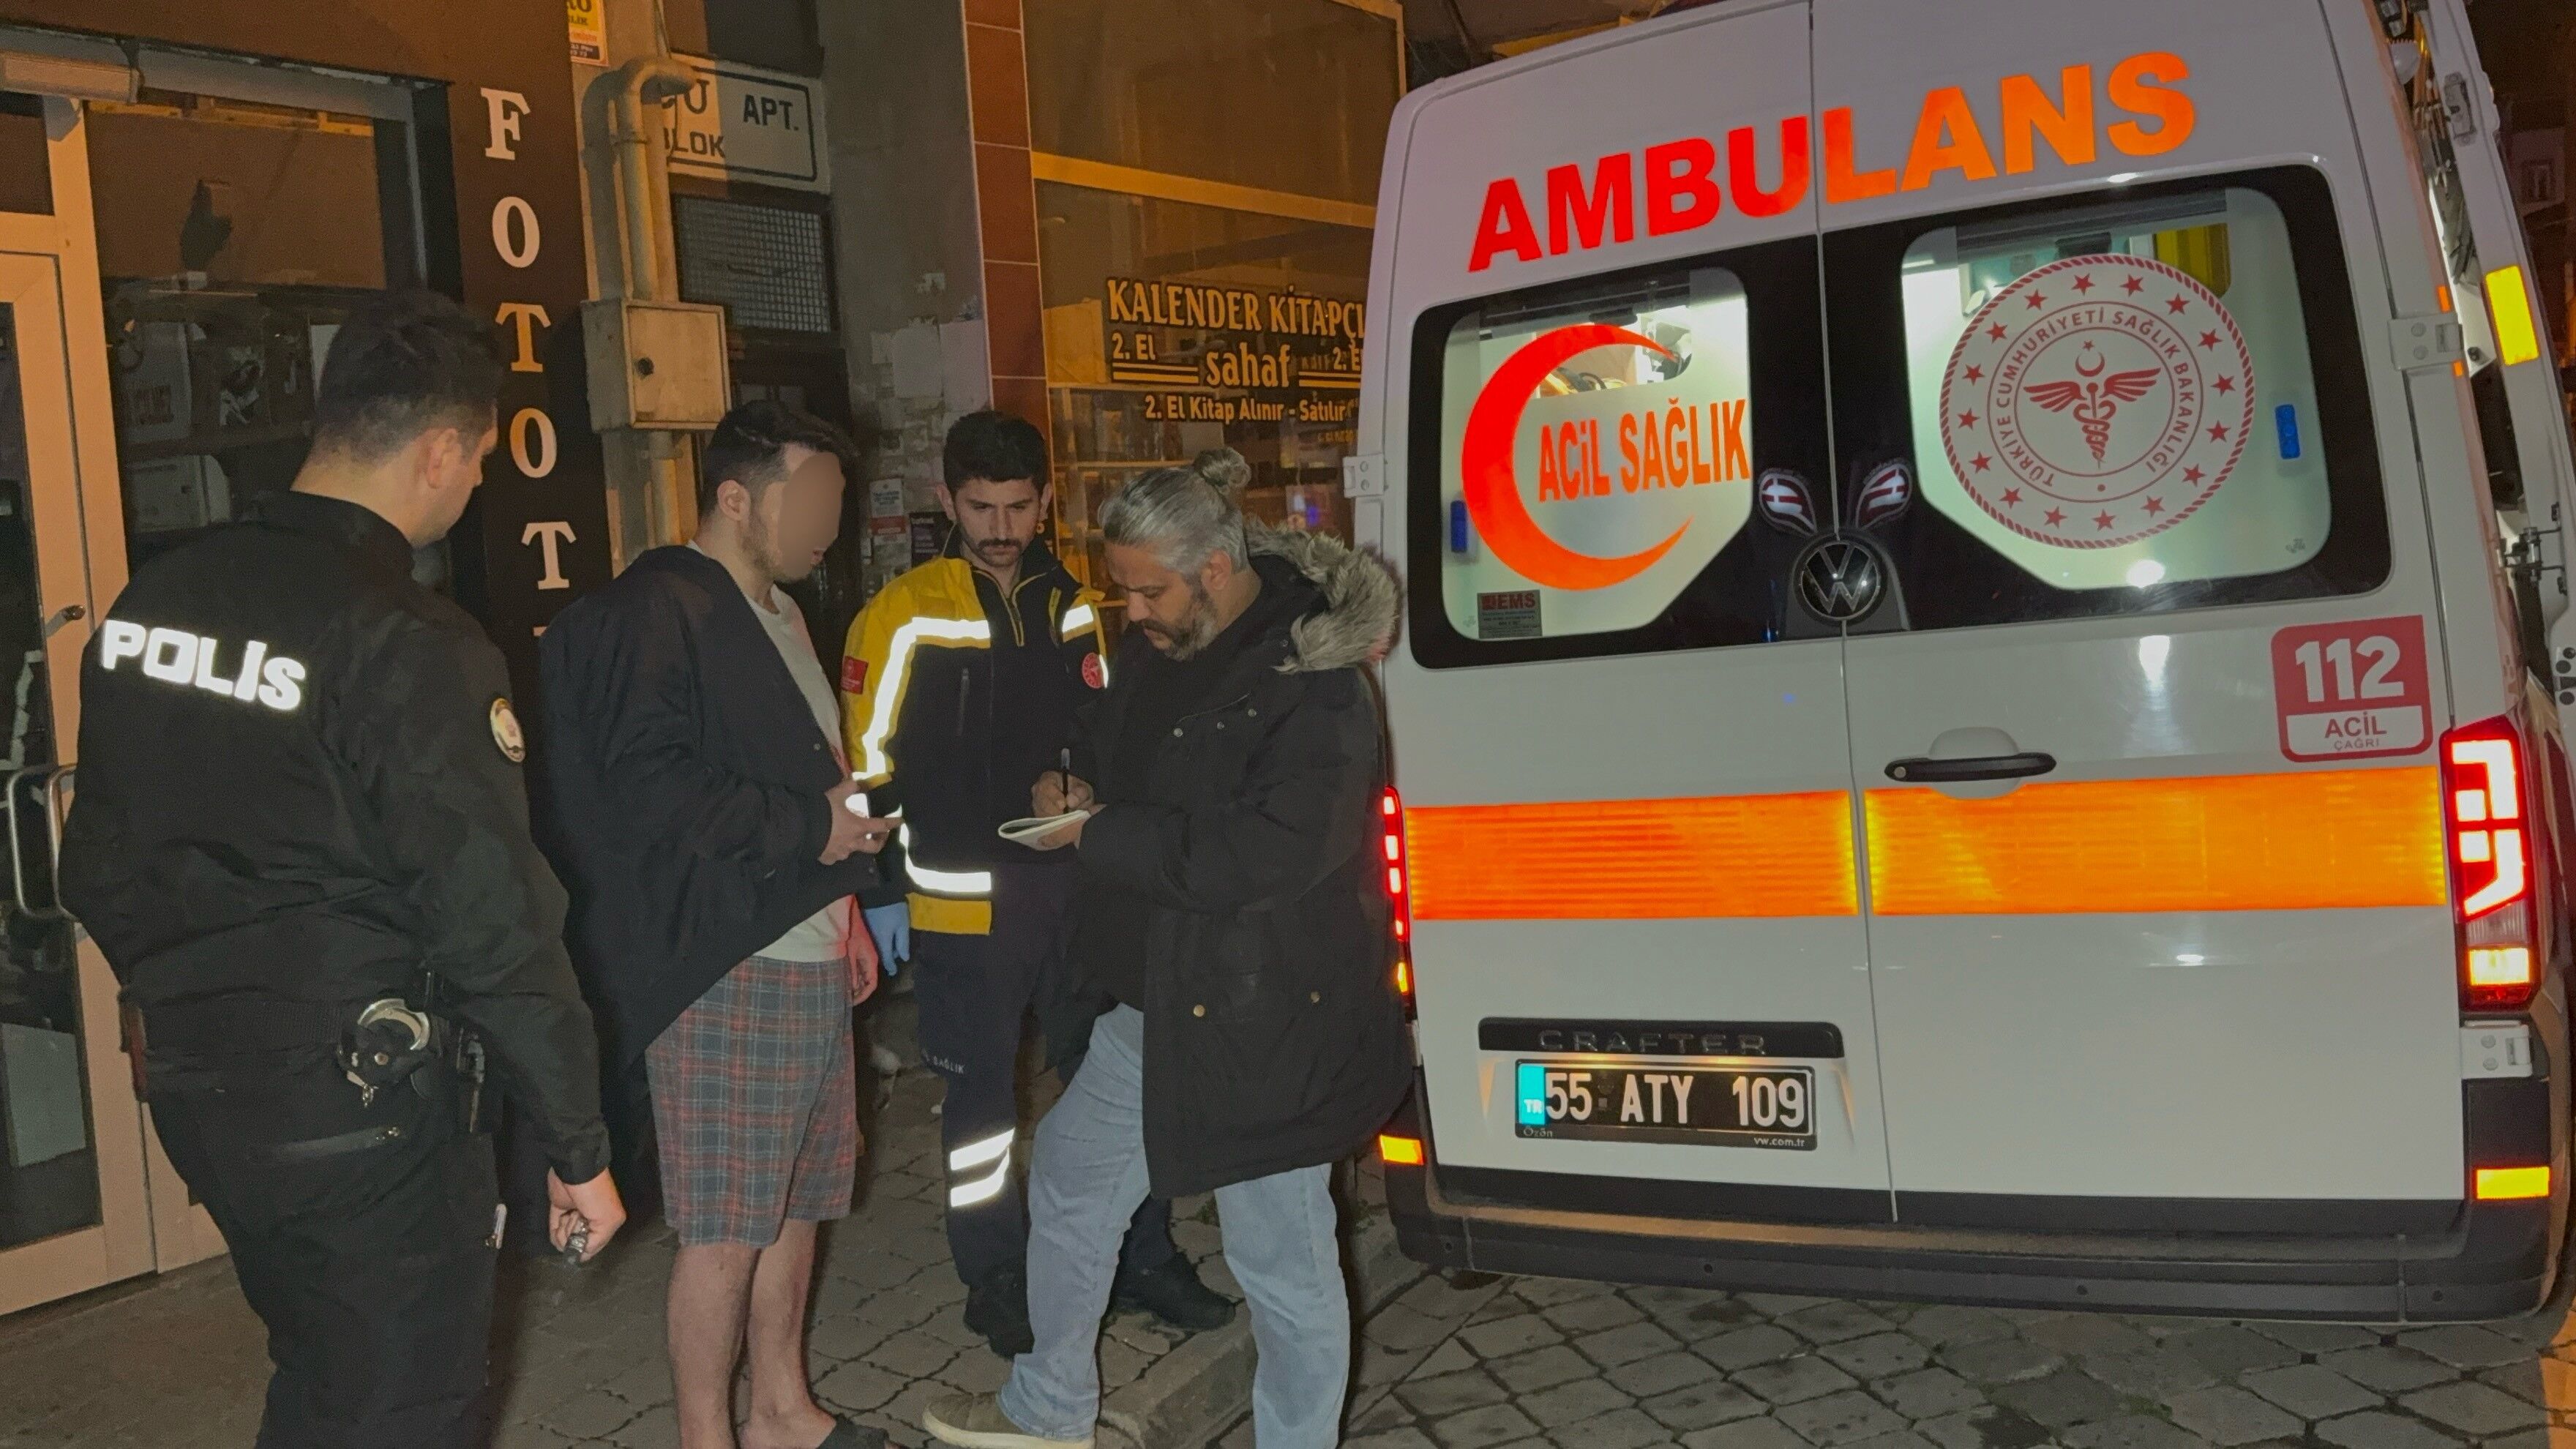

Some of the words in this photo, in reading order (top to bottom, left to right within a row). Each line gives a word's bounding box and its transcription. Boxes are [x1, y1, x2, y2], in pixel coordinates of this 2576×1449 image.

[743, 94, 799, 131] APT.
[1468, 52, 2196, 273] AMBULANS
[1107, 279, 1262, 332] KALENDER
[1112, 332, 1131, 359] 2.
[1135, 334, 1156, 360] El
[1996, 306, 2105, 408] CUMHURİYETİ
[2112, 310, 2181, 359] SAĞLIK
[1206, 342, 1291, 388] sahaf
[1145, 394, 1162, 419] 2.
[1167, 395, 1186, 419] El
[1189, 396, 1235, 425] Kitap
[1239, 397, 1284, 422] Alınır
[1299, 399, 1347, 422] Satılır
[2145, 362, 2195, 473] BAKANLIĞI
[1618, 397, 1751, 494] SAĞLIK
[1996, 414, 2055, 487] TÜRKİYE
[101, 619, 307, 711] POLİS
[2295, 635, 2405, 703] 112
[2324, 711, 2388, 739] ACİL
[2333, 735, 2380, 752] ÇAĞRI
[1538, 1030, 1767, 1055] CRAFTER
[1523, 1098, 1543, 1115] TR
[1545, 1072, 1592, 1120] 55
[1620, 1074, 1694, 1124] ATY
[1731, 1075, 1805, 1128] 109
